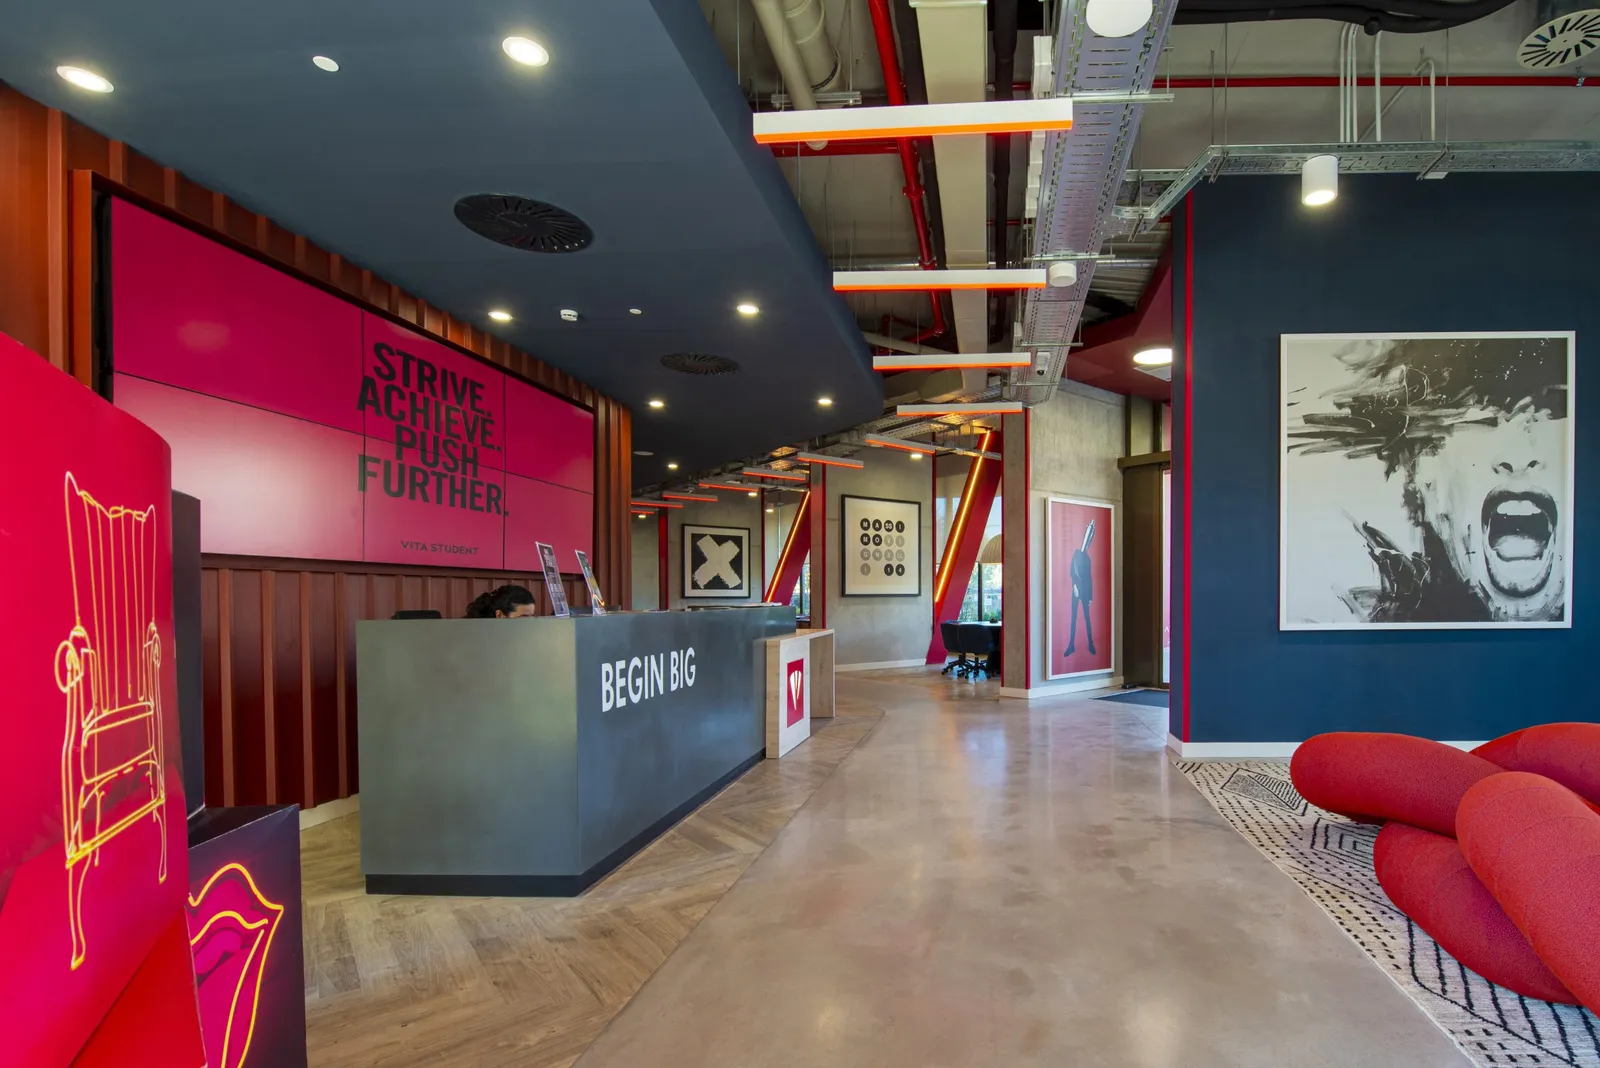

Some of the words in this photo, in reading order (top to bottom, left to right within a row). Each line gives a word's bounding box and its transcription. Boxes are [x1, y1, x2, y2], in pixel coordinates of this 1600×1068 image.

[373, 342, 492, 417] STRIVE.
[356, 375, 502, 452] ACHIEVE.
[394, 424, 479, 478] PUSH
[357, 454, 510, 516] FURTHER.
[400, 540, 428, 551] VITA
[430, 543, 479, 555] STUDENT
[601, 652, 664, 713] BEGIN
[670, 646, 696, 692] BIG
